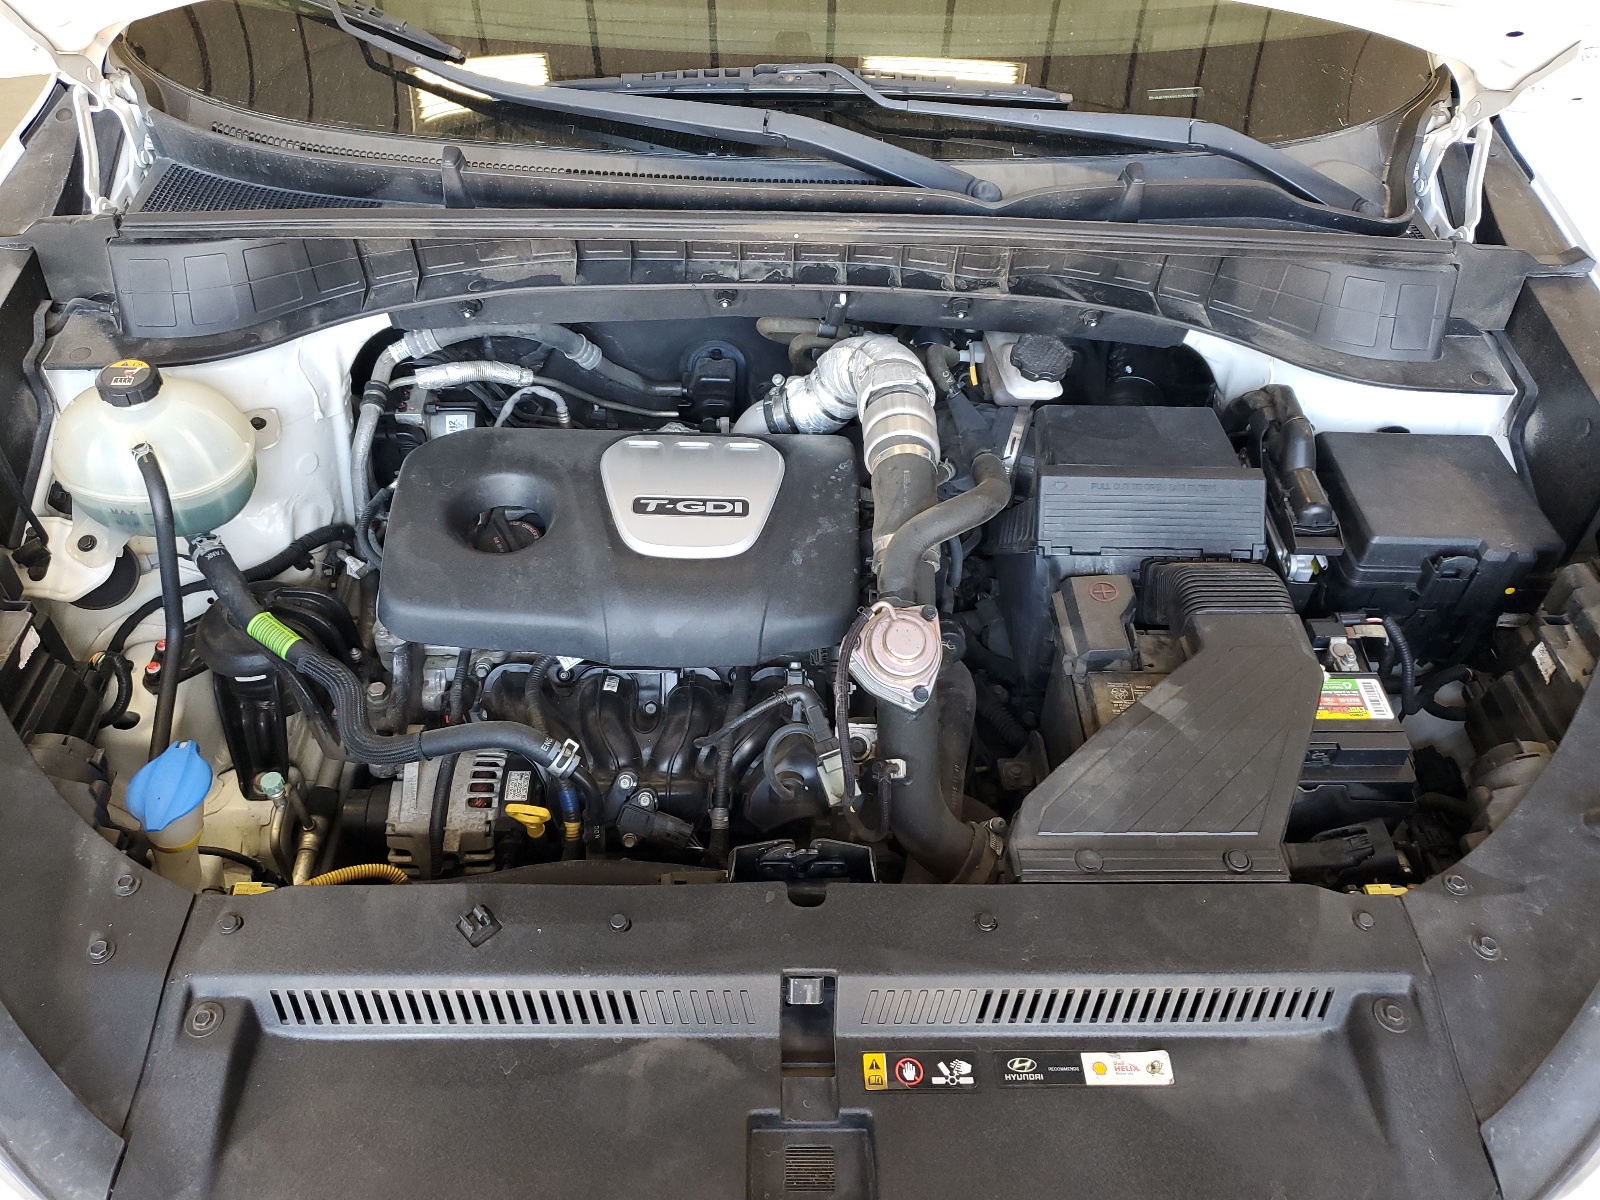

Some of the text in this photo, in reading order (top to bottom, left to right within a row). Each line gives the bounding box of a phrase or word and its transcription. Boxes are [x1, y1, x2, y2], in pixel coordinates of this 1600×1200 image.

[1113, 482, 1129, 490] OUT
[640, 500, 743, 514] T-GDI
[205, 550, 225, 560] TANK
